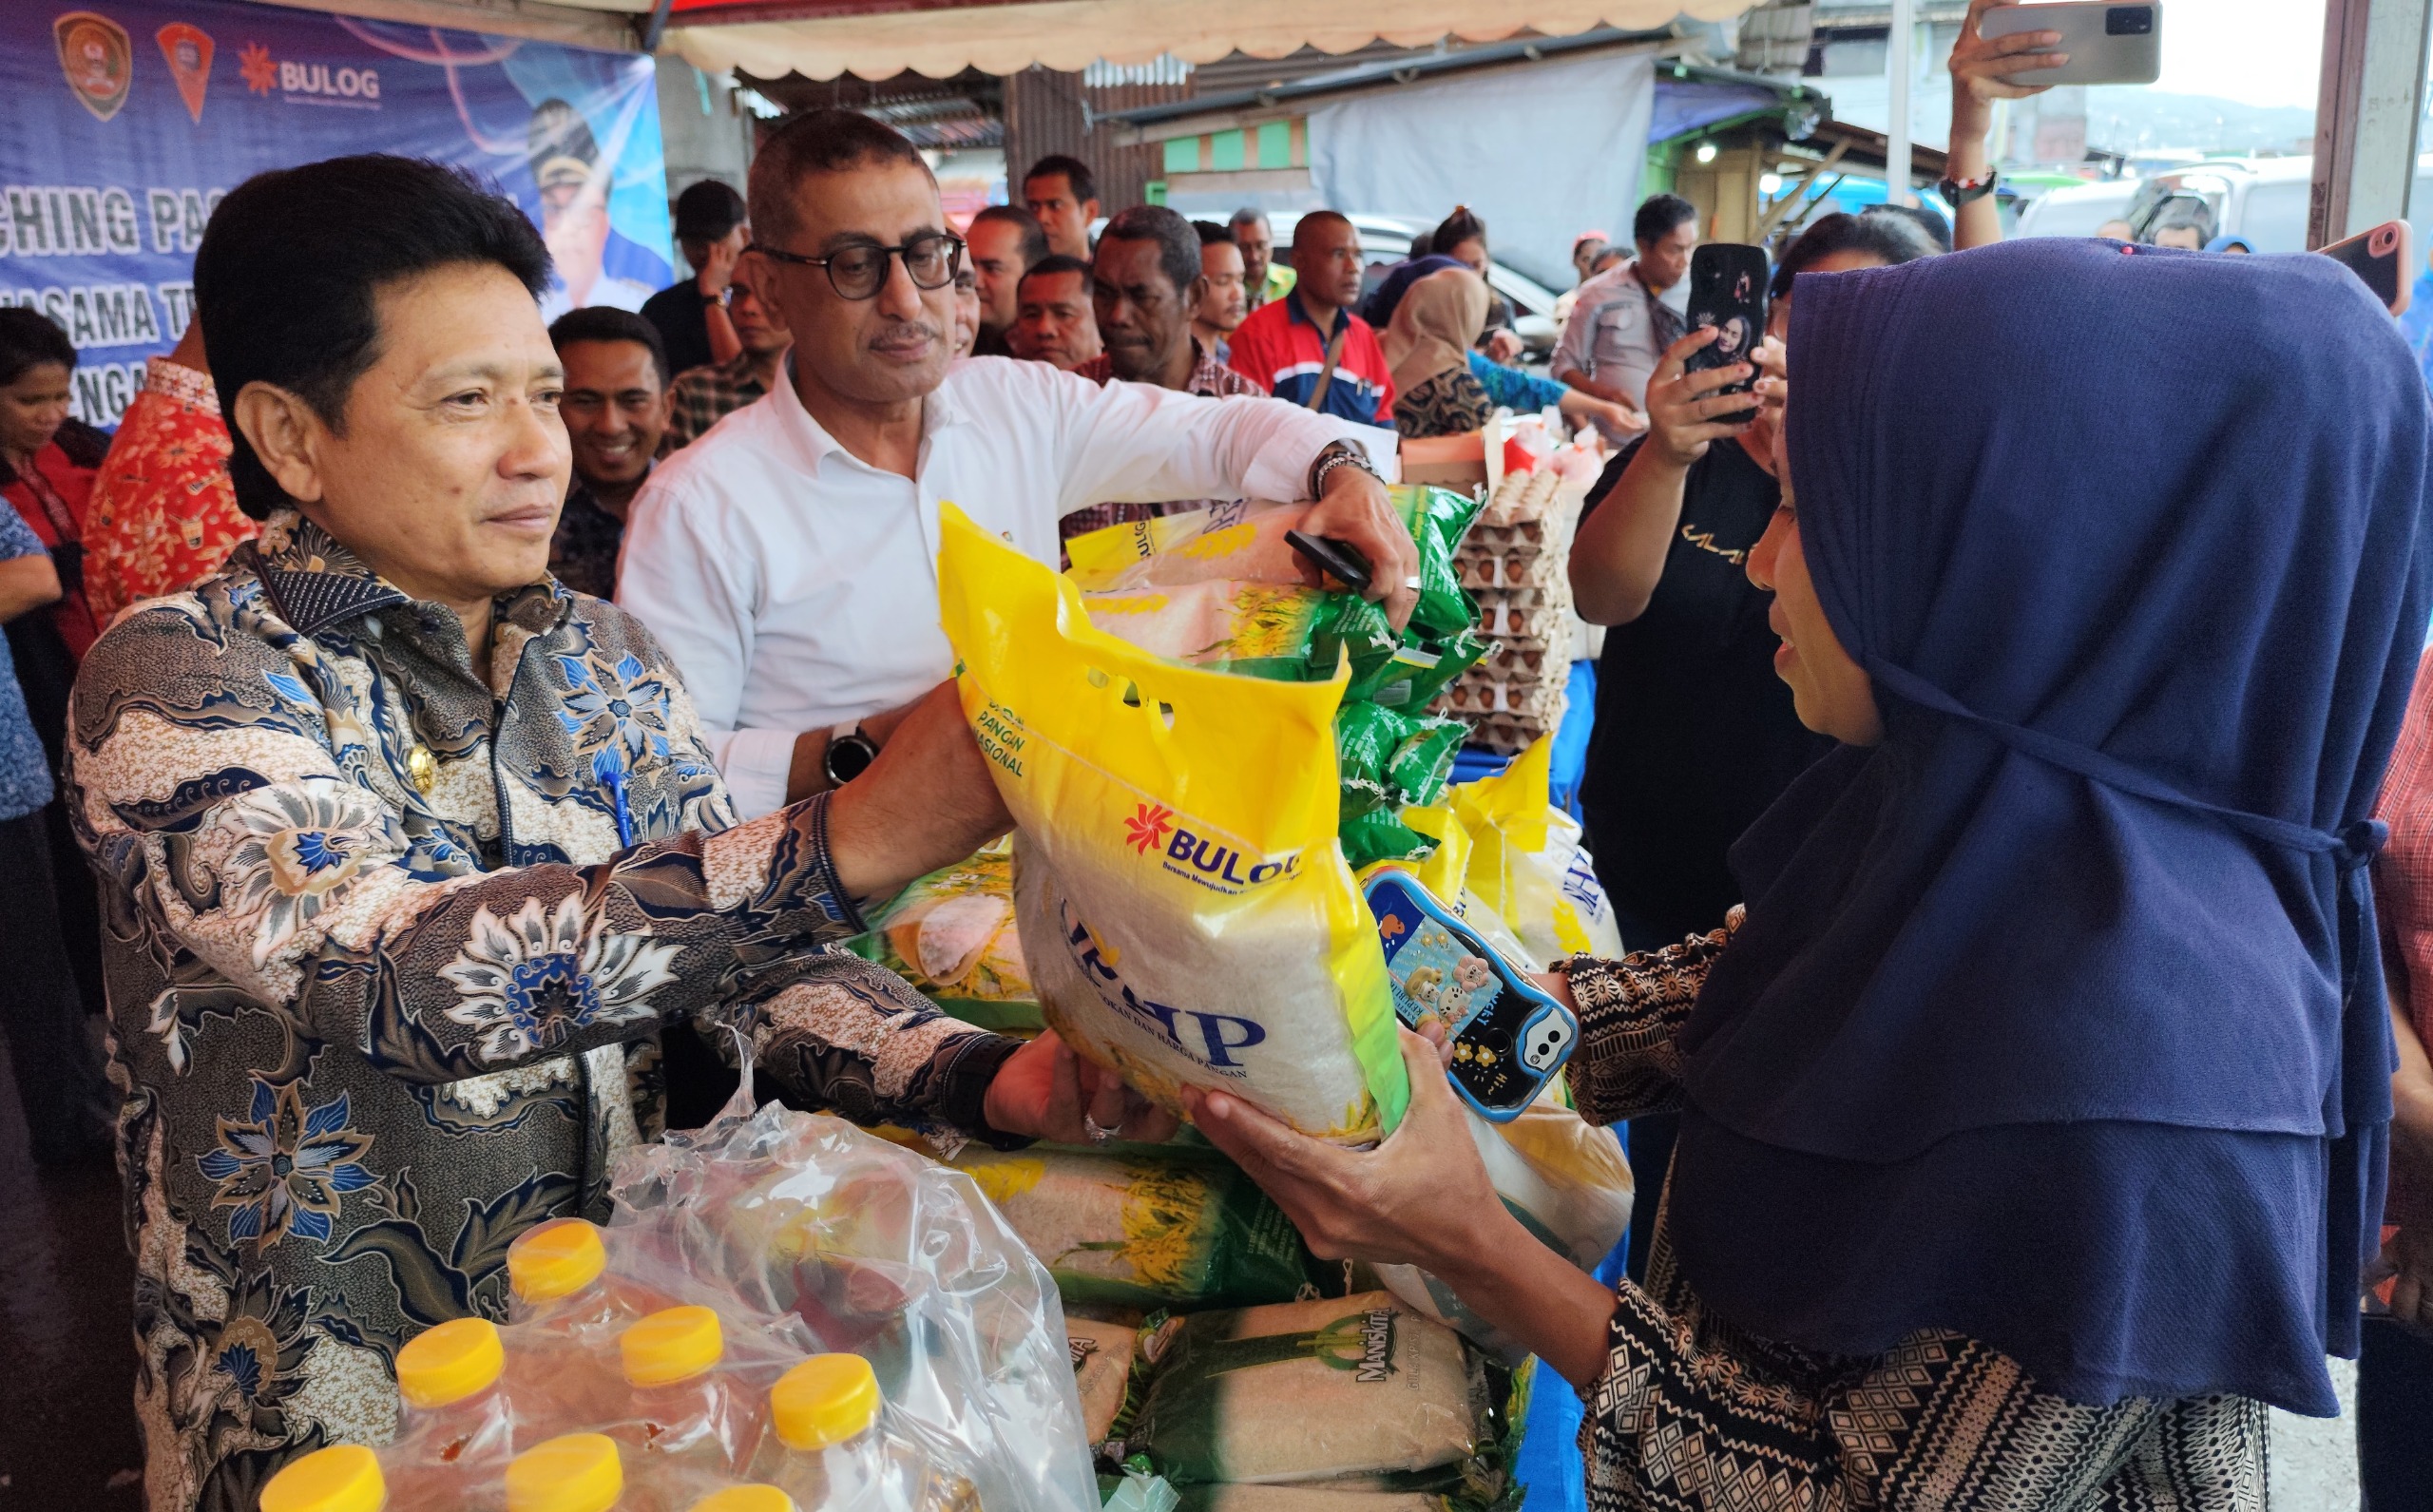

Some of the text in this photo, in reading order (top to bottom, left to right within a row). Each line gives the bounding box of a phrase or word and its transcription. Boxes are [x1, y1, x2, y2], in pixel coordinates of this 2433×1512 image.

[280, 60, 380, 99] BULOG
[1162, 860, 1190, 879] Bersama
[1134, 1016, 1156, 1036] DAN
[1158, 1032, 1195, 1062] HARGA
[1197, 1057, 1248, 1079] PANGAN
